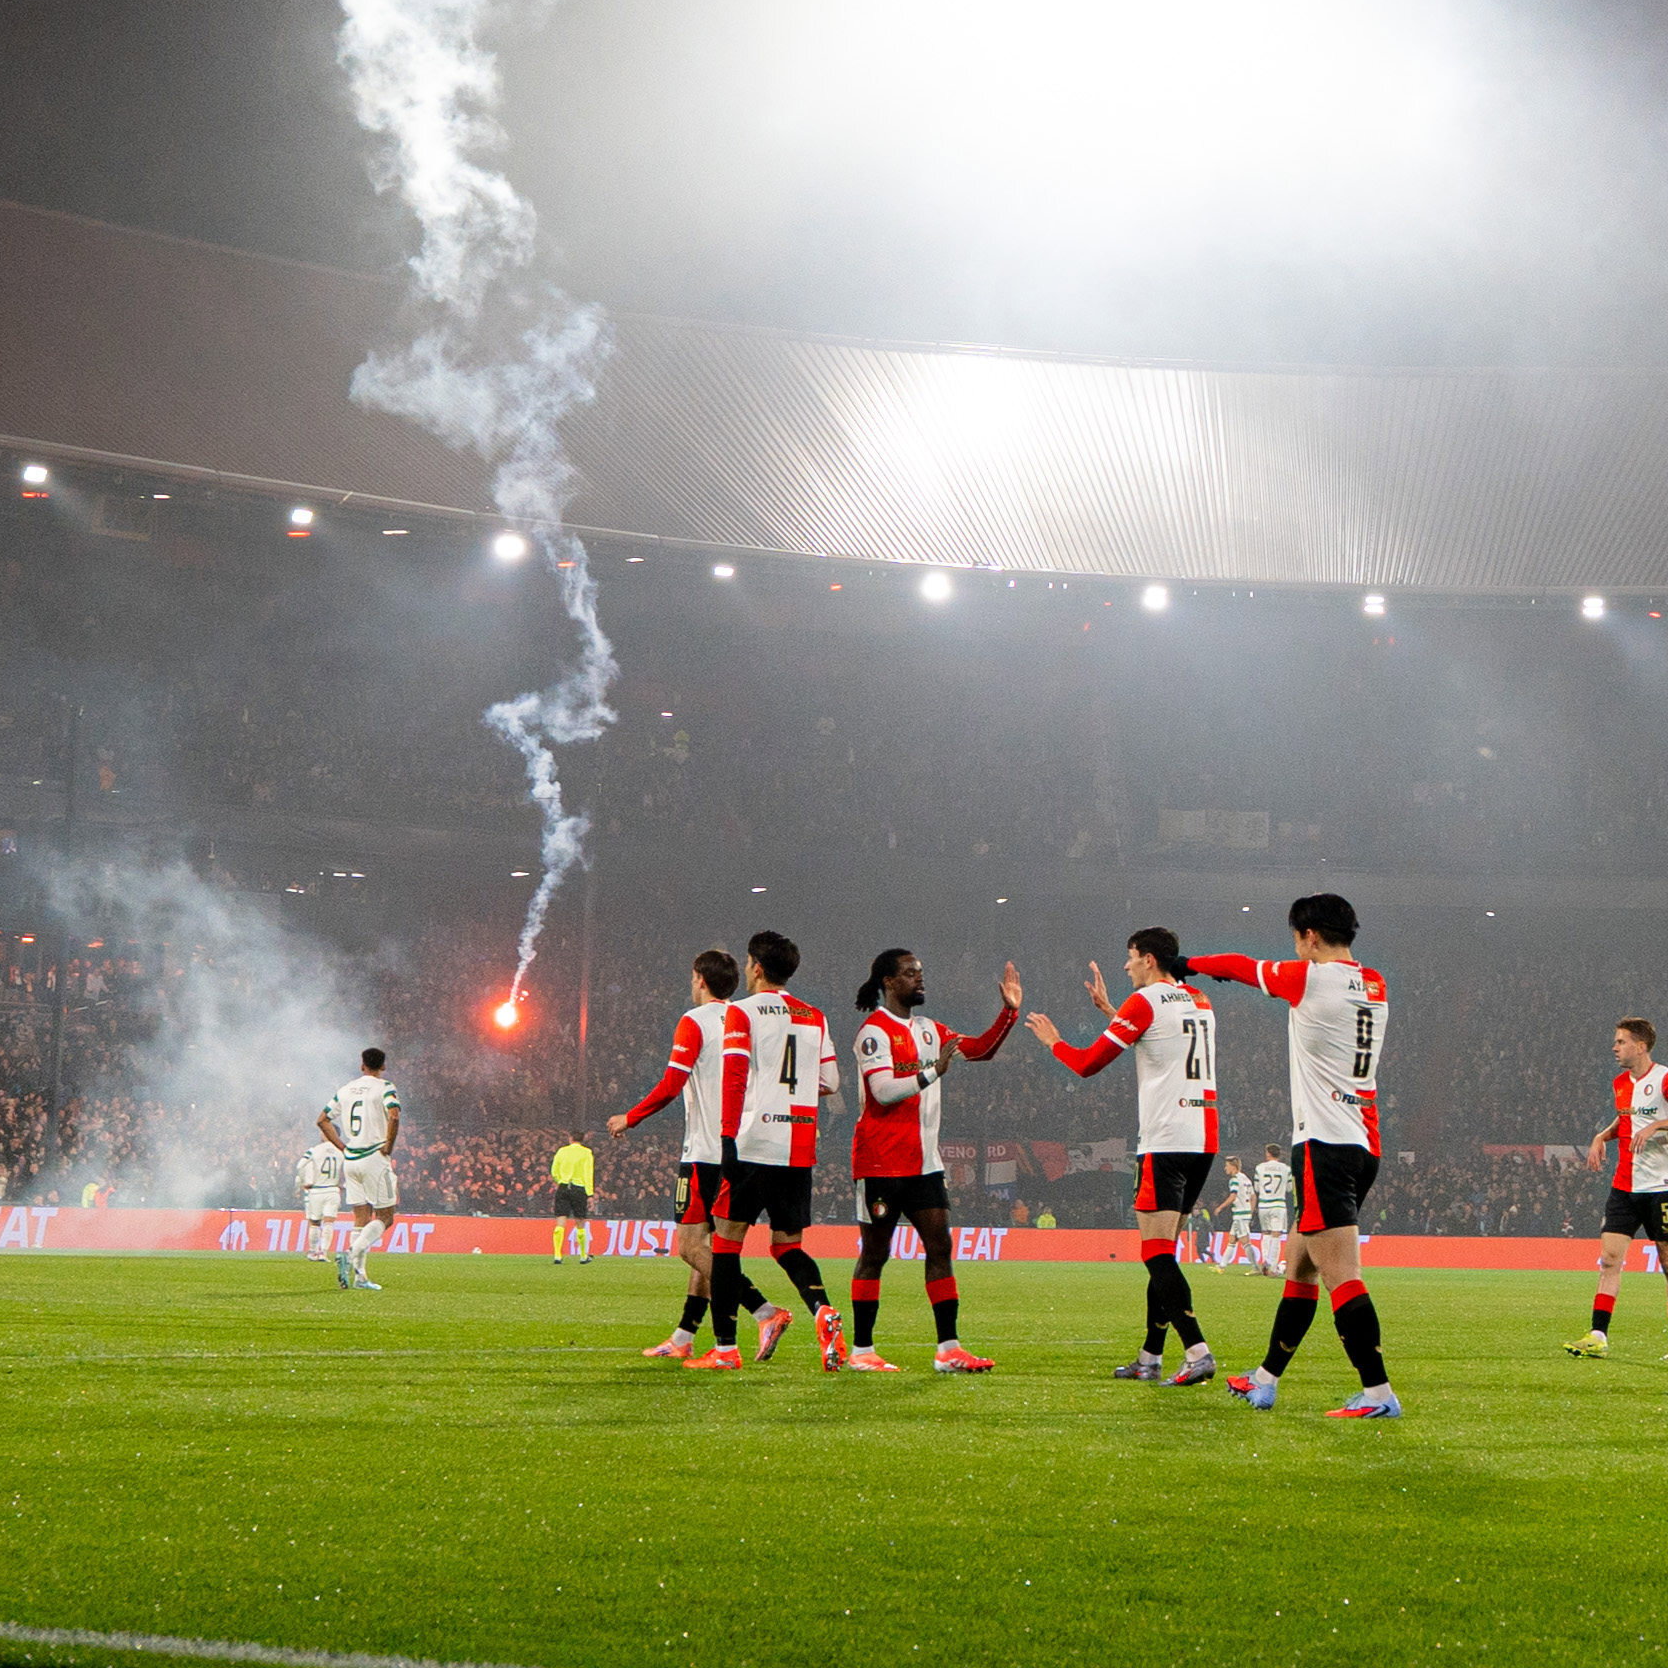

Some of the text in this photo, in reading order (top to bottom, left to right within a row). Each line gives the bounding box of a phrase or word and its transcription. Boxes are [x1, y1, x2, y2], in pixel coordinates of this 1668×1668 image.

[779, 1034, 798, 1095] 4
[1182, 1019, 1211, 1080] 21
[350, 1100, 363, 1137] 6
[321, 1157, 337, 1180] 41
[1263, 1174, 1283, 1194] 27
[676, 1177, 689, 1202] 16
[266, 1219, 434, 1253] JUT AT
[603, 1220, 677, 1257] JUST
[956, 1227, 1008, 1261] EAT
